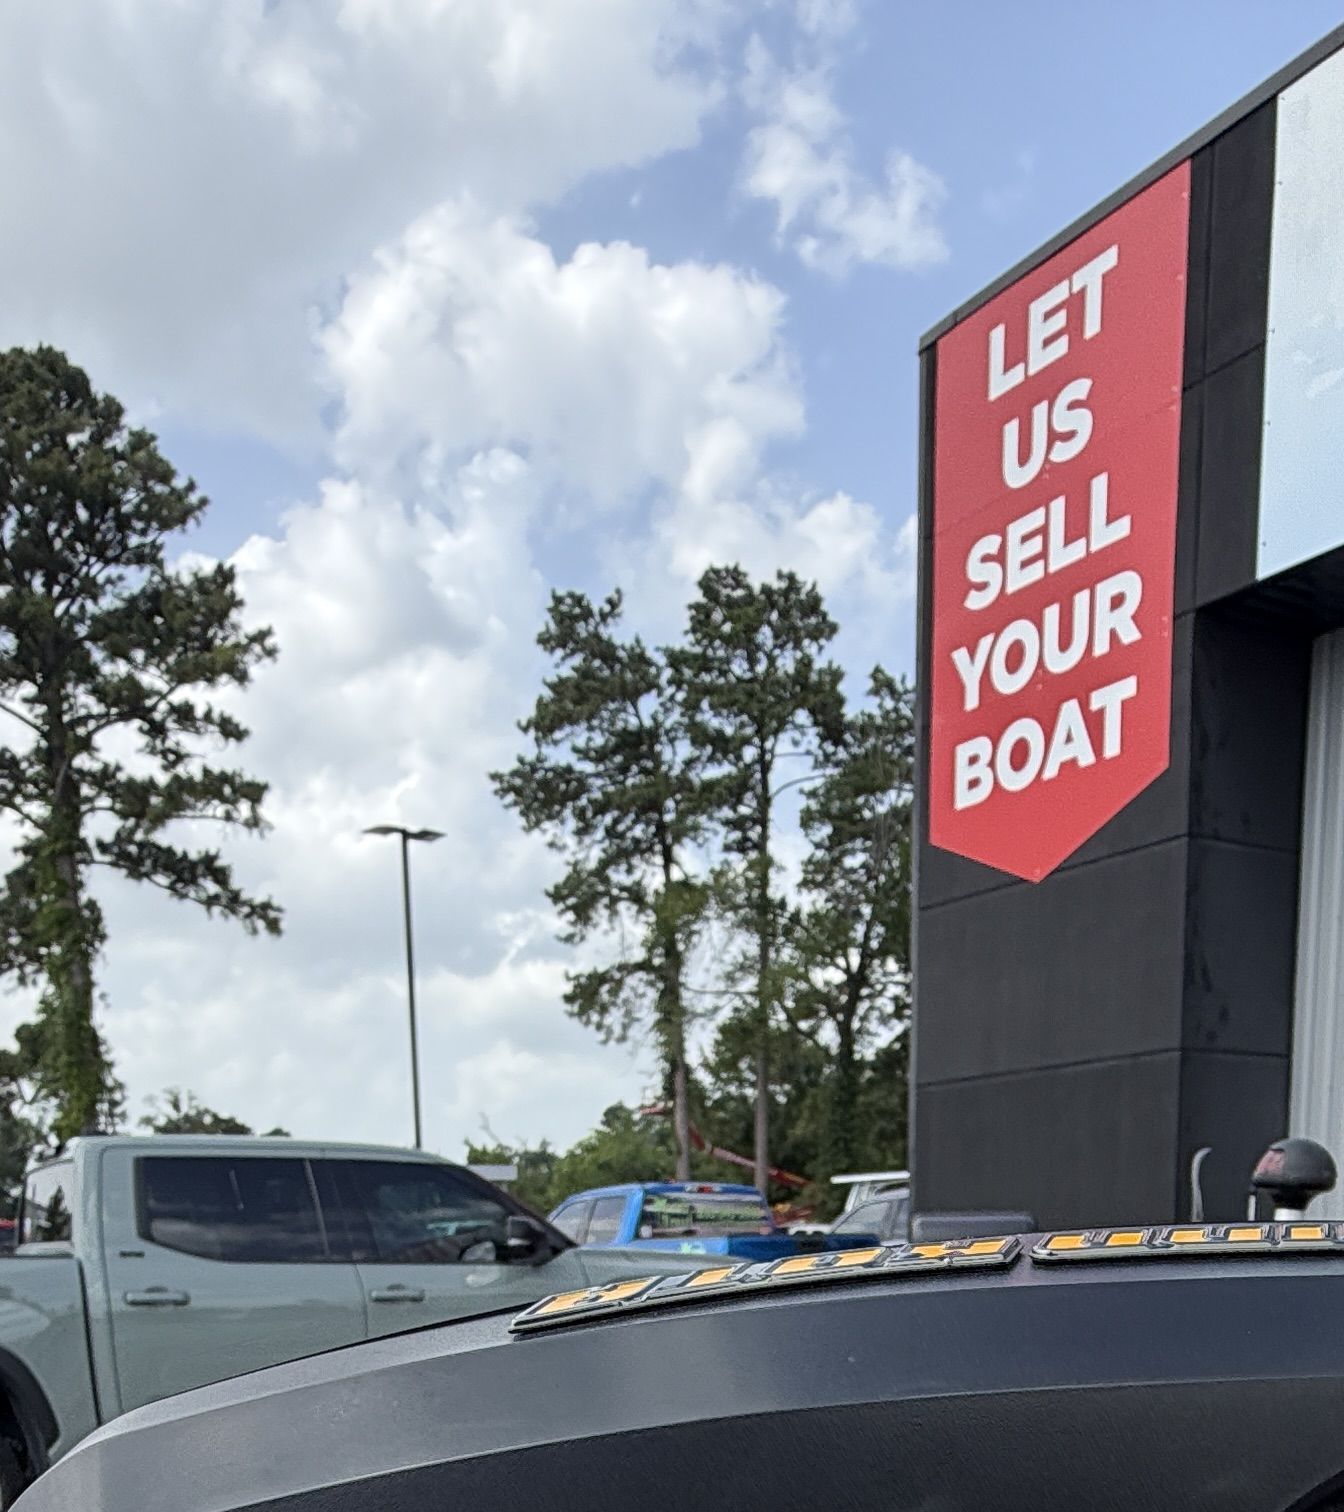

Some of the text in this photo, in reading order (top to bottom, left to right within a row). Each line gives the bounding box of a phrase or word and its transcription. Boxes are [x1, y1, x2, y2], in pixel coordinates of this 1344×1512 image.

[988, 245, 1118, 401] LET
[1002, 378, 1094, 489] US
[964, 472, 1131, 612] SELL
[951, 570, 1144, 711] YOUR
[953, 678, 1137, 810] BOAT
